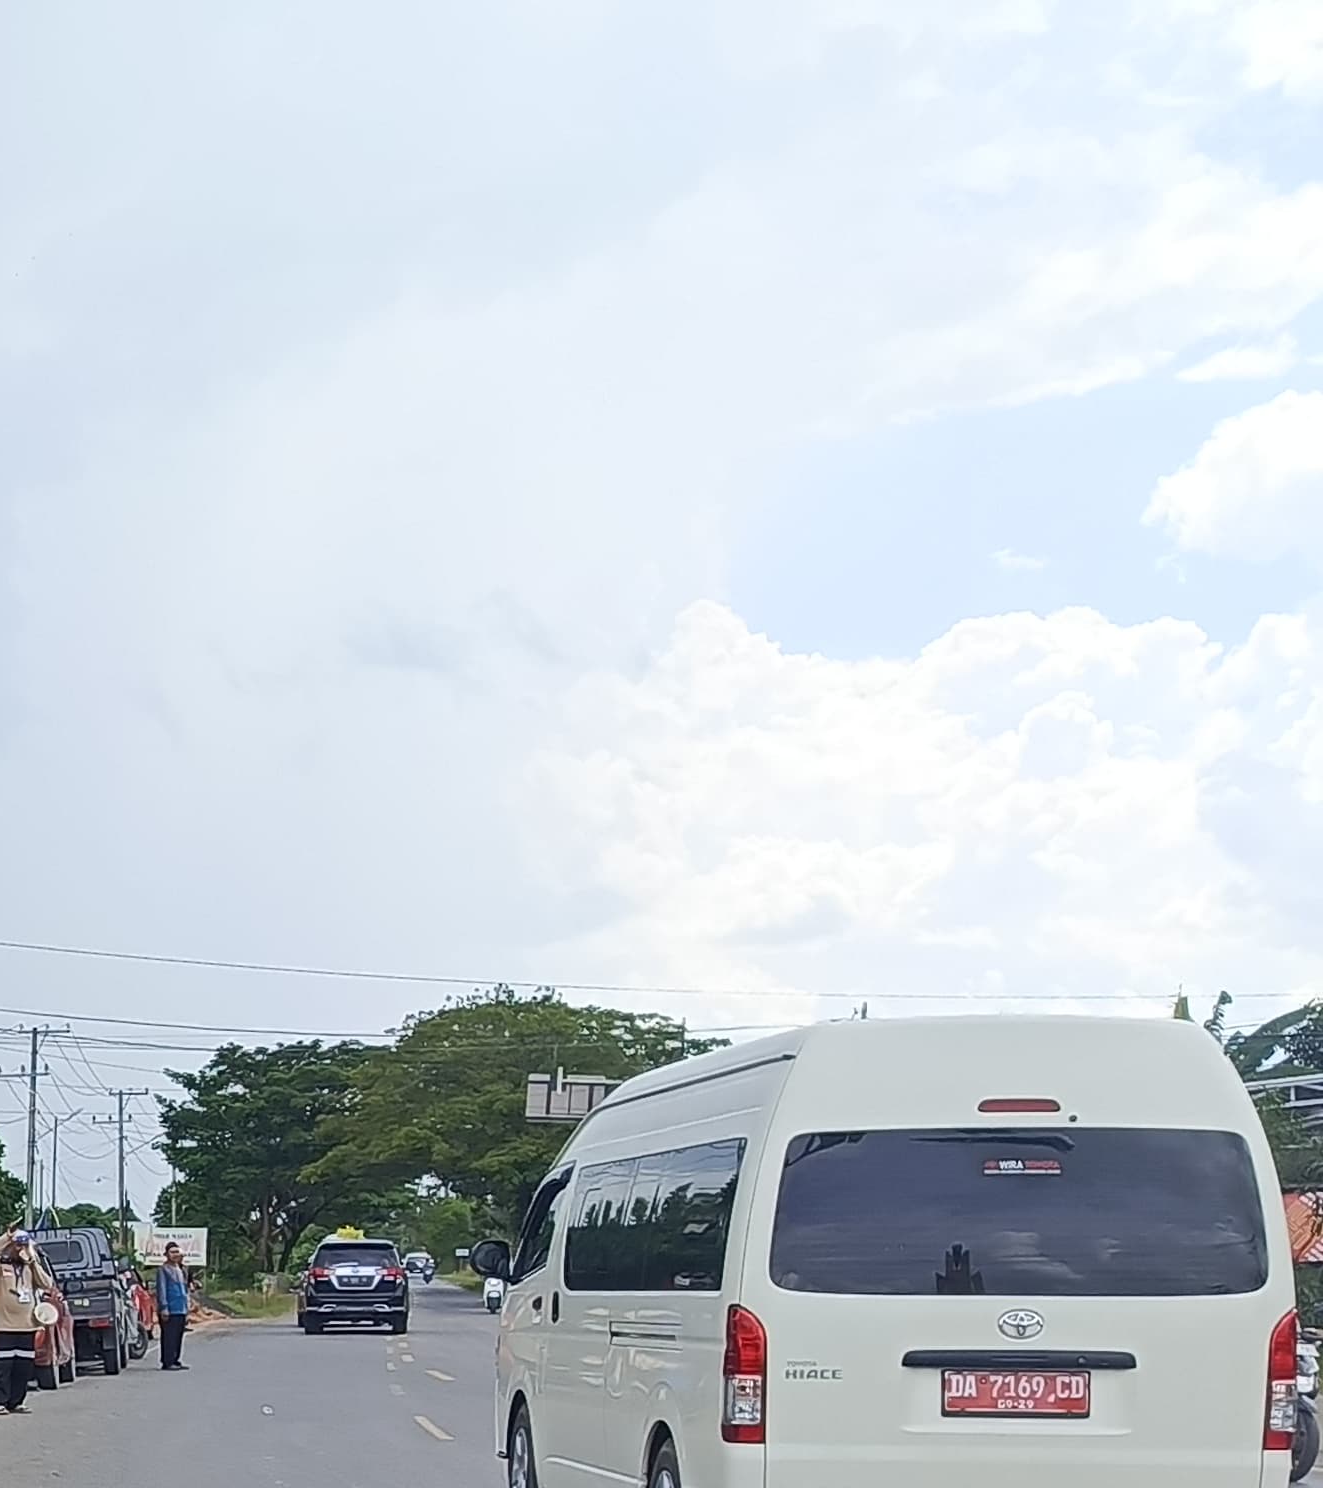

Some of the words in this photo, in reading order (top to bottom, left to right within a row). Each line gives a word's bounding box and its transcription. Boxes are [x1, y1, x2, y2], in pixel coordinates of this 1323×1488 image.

[785, 1369, 843, 1380] HIACE
[948, 1376, 977, 1398] DA
[989, 1376, 1045, 1398] 7169
[1055, 1377, 1085, 1399] CD
